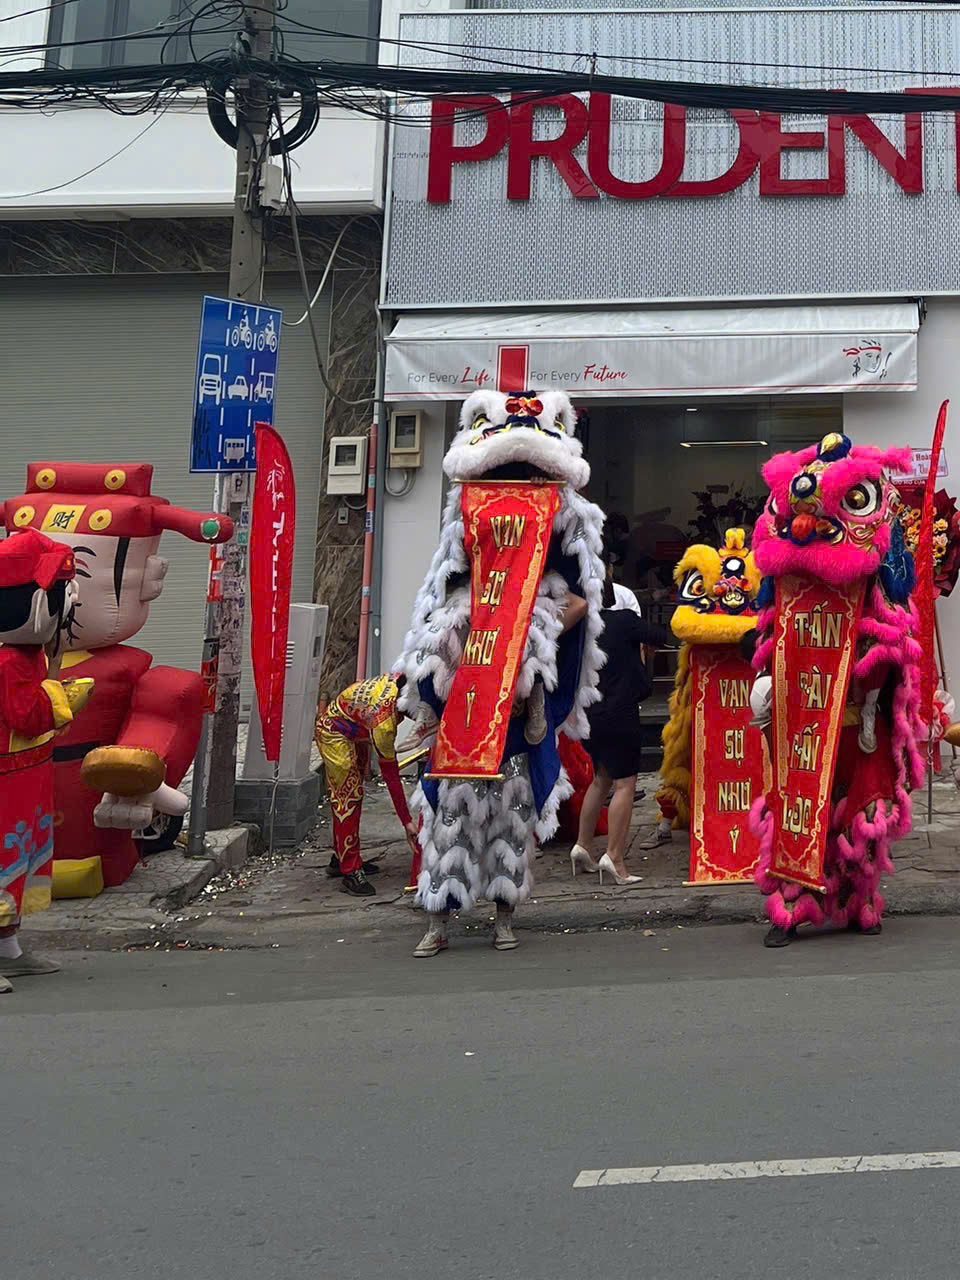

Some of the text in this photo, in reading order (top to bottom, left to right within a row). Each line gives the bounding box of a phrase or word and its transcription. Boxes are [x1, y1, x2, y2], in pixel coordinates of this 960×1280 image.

[407, 372, 426, 383] For
[429, 372, 459, 385] Every
[530, 370, 547, 382] For
[551, 371, 581, 383] Every
[583, 363, 629, 382] Future
[49, 510, 76, 529] 财
[490, 515, 526, 553] VẠN
[794, 600, 843, 648] TẤN
[462, 626, 500, 665] NHƯ
[718, 679, 752, 853] VẠN SỰ NHƯ Ý
[782, 788, 813, 841] LỘC
